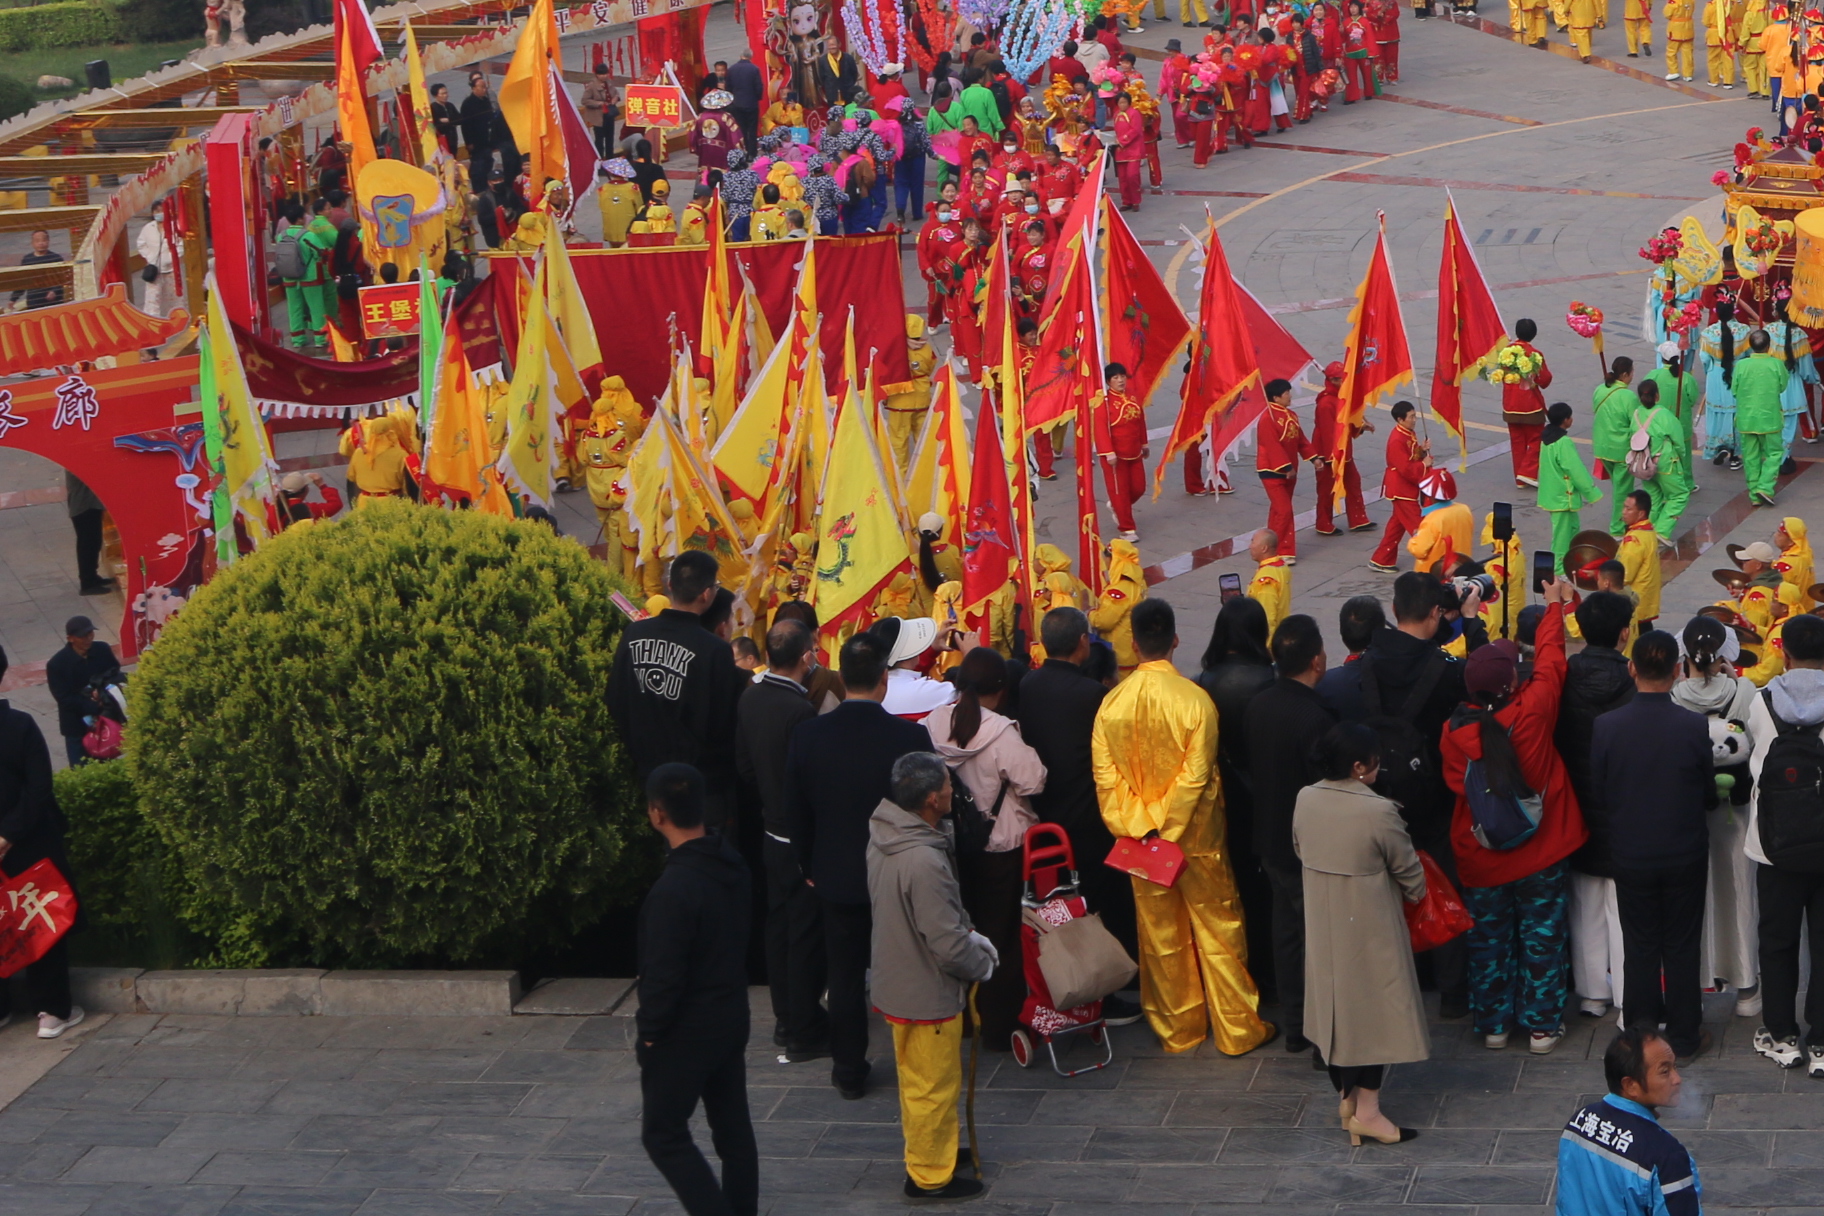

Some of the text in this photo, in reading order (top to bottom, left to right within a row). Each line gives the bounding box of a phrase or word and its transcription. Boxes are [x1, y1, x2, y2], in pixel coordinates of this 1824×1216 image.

[627, 96, 679, 116] 弹音社
[628, 638, 696, 677] THANK
[633, 667, 683, 701] YOU
[1568, 1107, 1634, 1154] 上海宝冶
